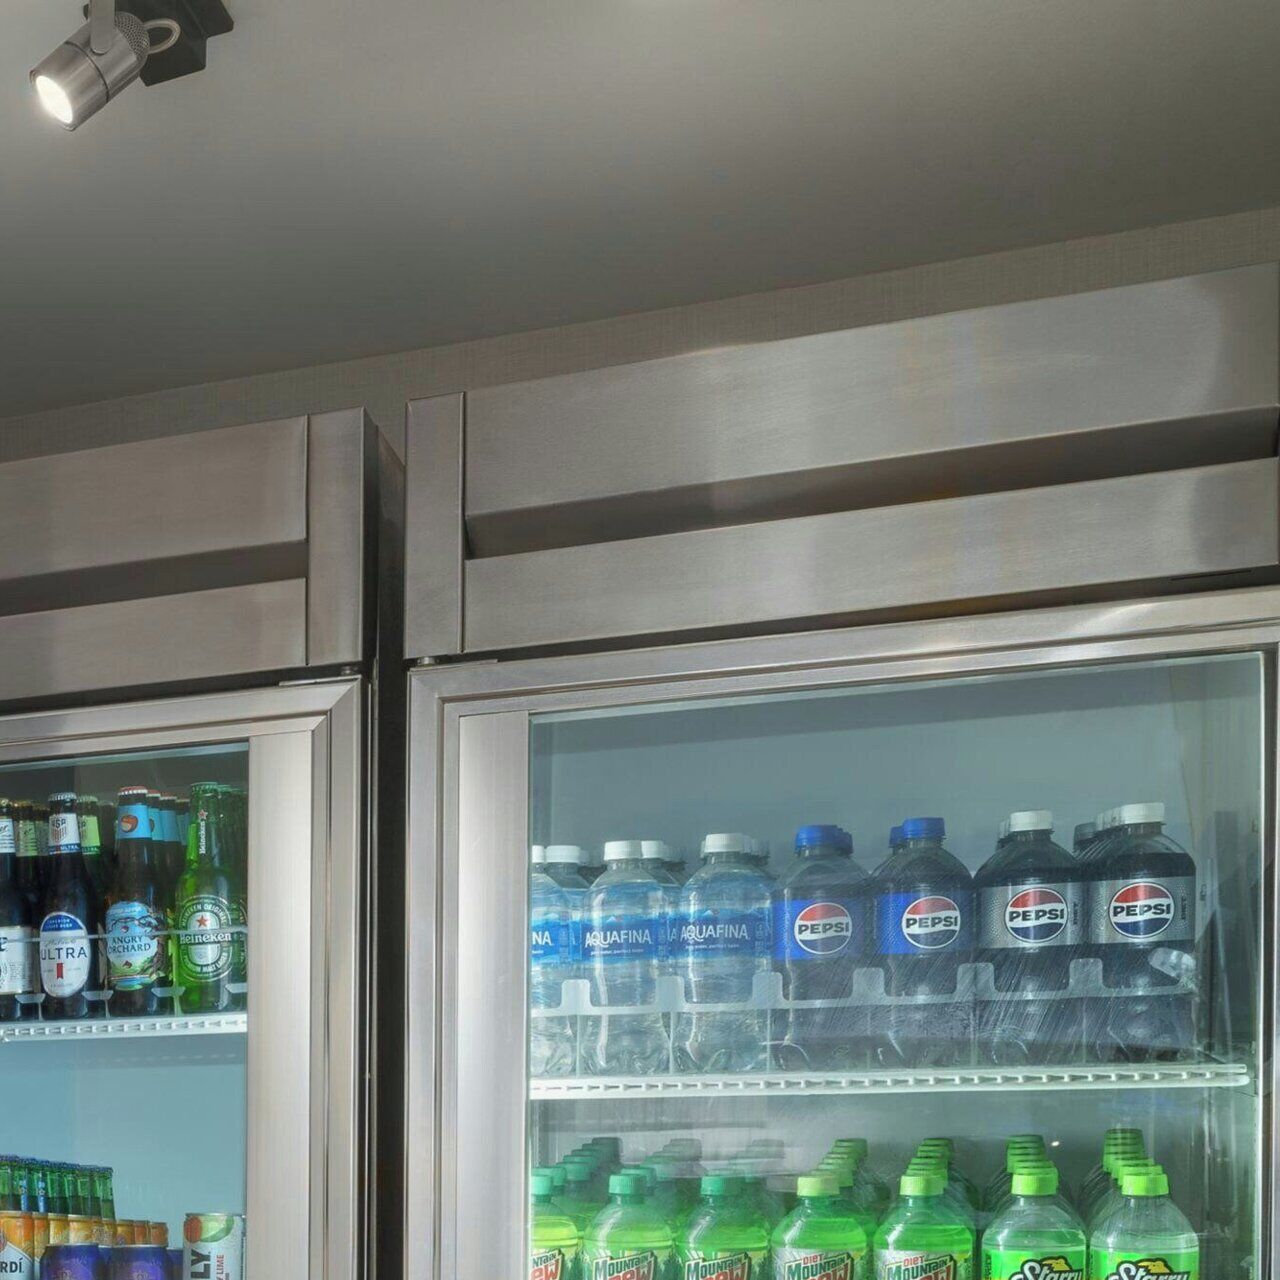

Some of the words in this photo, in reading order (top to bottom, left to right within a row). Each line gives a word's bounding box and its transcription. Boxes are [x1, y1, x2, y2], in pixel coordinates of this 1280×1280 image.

[1008, 907, 1065, 923] PEPSI
[1112, 902, 1171, 918] PEPSI
[797, 921, 849, 936] PEPSI
[905, 916, 959, 930] PEPSI
[111, 934, 143, 945] ANGRY
[179, 932, 233, 945] Heineken
[585, 928, 652, 949] AQUAFINA
[681, 922, 749, 942] AQUAFINA
